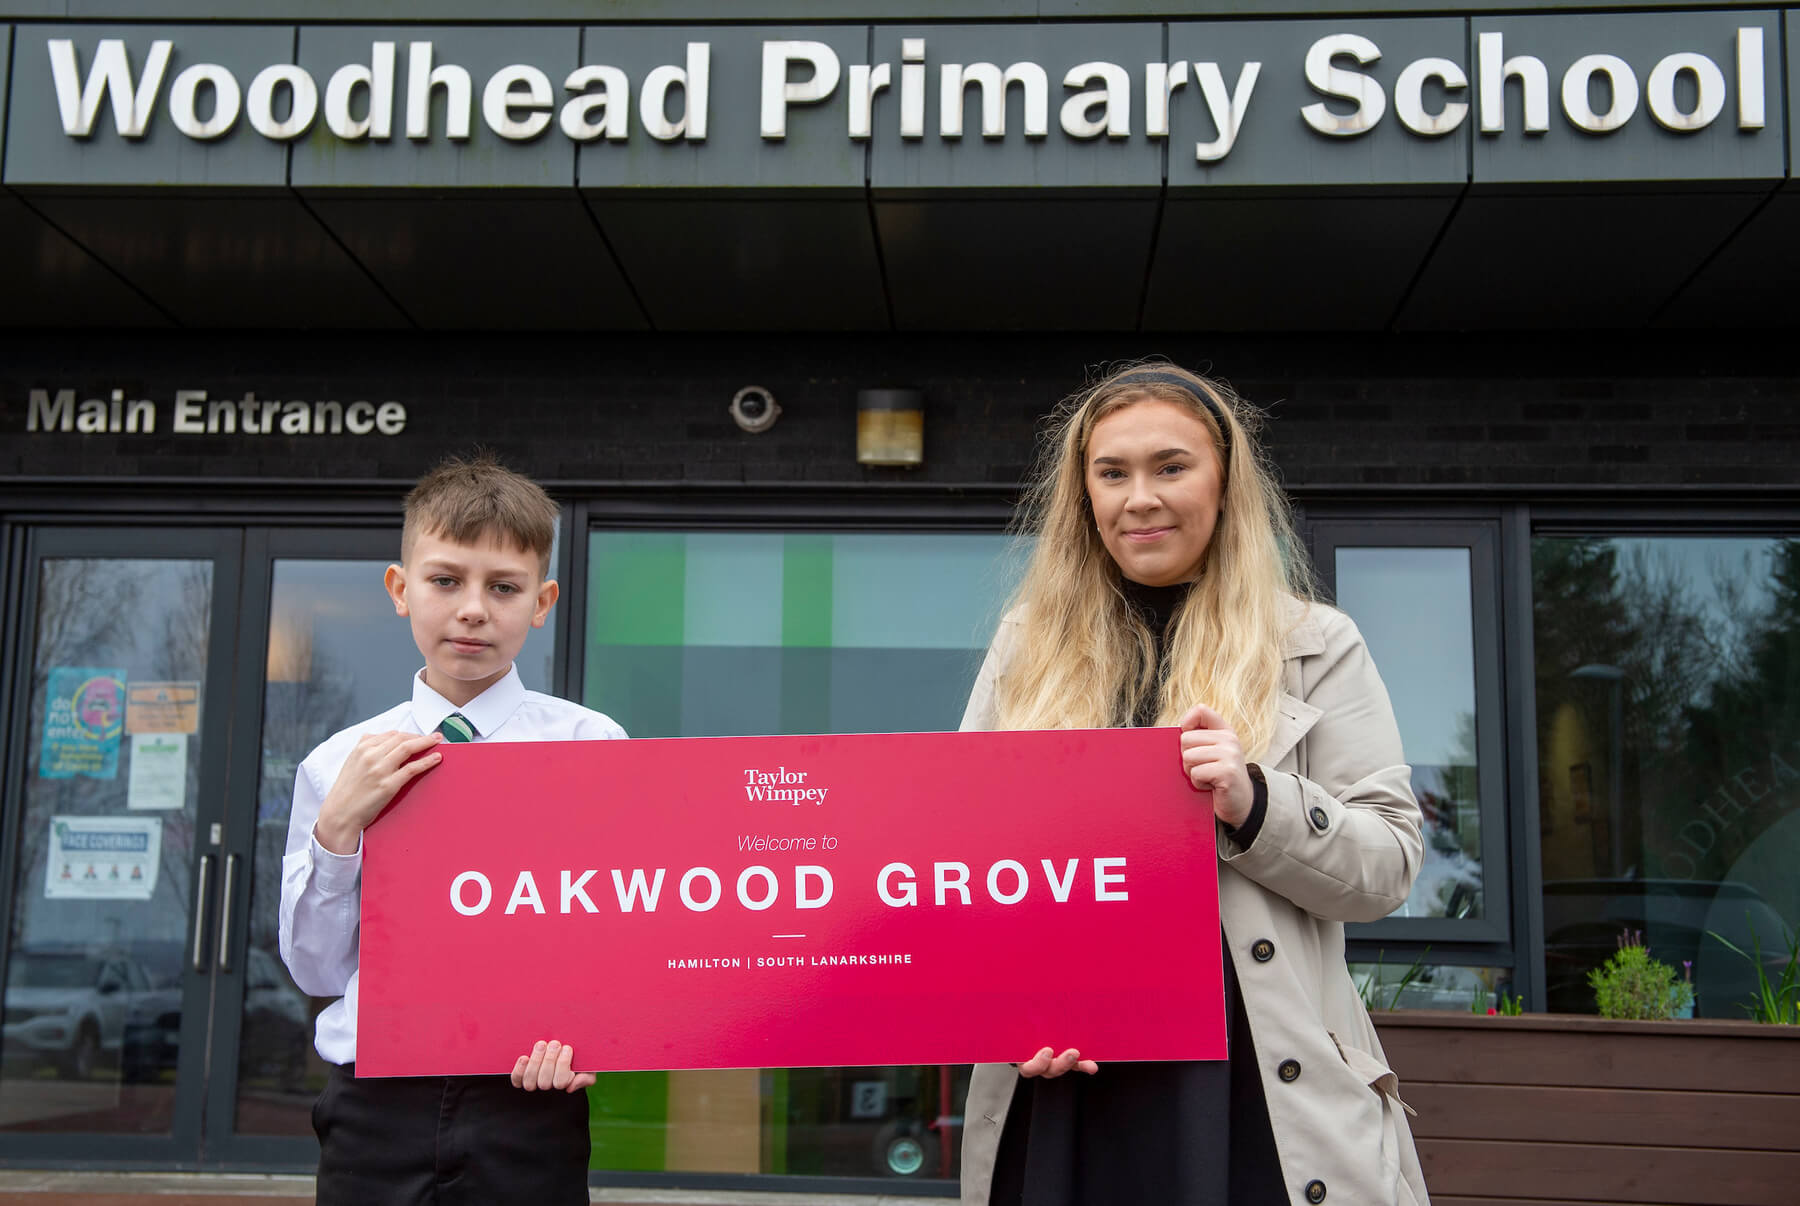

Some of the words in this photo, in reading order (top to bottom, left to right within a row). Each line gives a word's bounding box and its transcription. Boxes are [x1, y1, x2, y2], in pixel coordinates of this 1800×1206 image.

[47, 38, 712, 141] Woodhead
[760, 37, 1264, 162] Primary
[1300, 26, 1766, 137] School
[26, 388, 156, 434] Main
[172, 389, 408, 436] Entrance
[744, 766, 808, 792] Taylor
[744, 784, 829, 807] Wimpey
[737, 834, 818, 853] Welcome
[821, 833, 839, 851] to
[449, 865, 835, 916] OAKWOOD
[875, 857, 1129, 908] GROVE
[667, 957, 741, 970] HAMILTON
[756, 956, 805, 968] SOUTH
[810, 953, 913, 967] LANARKSHIRE
